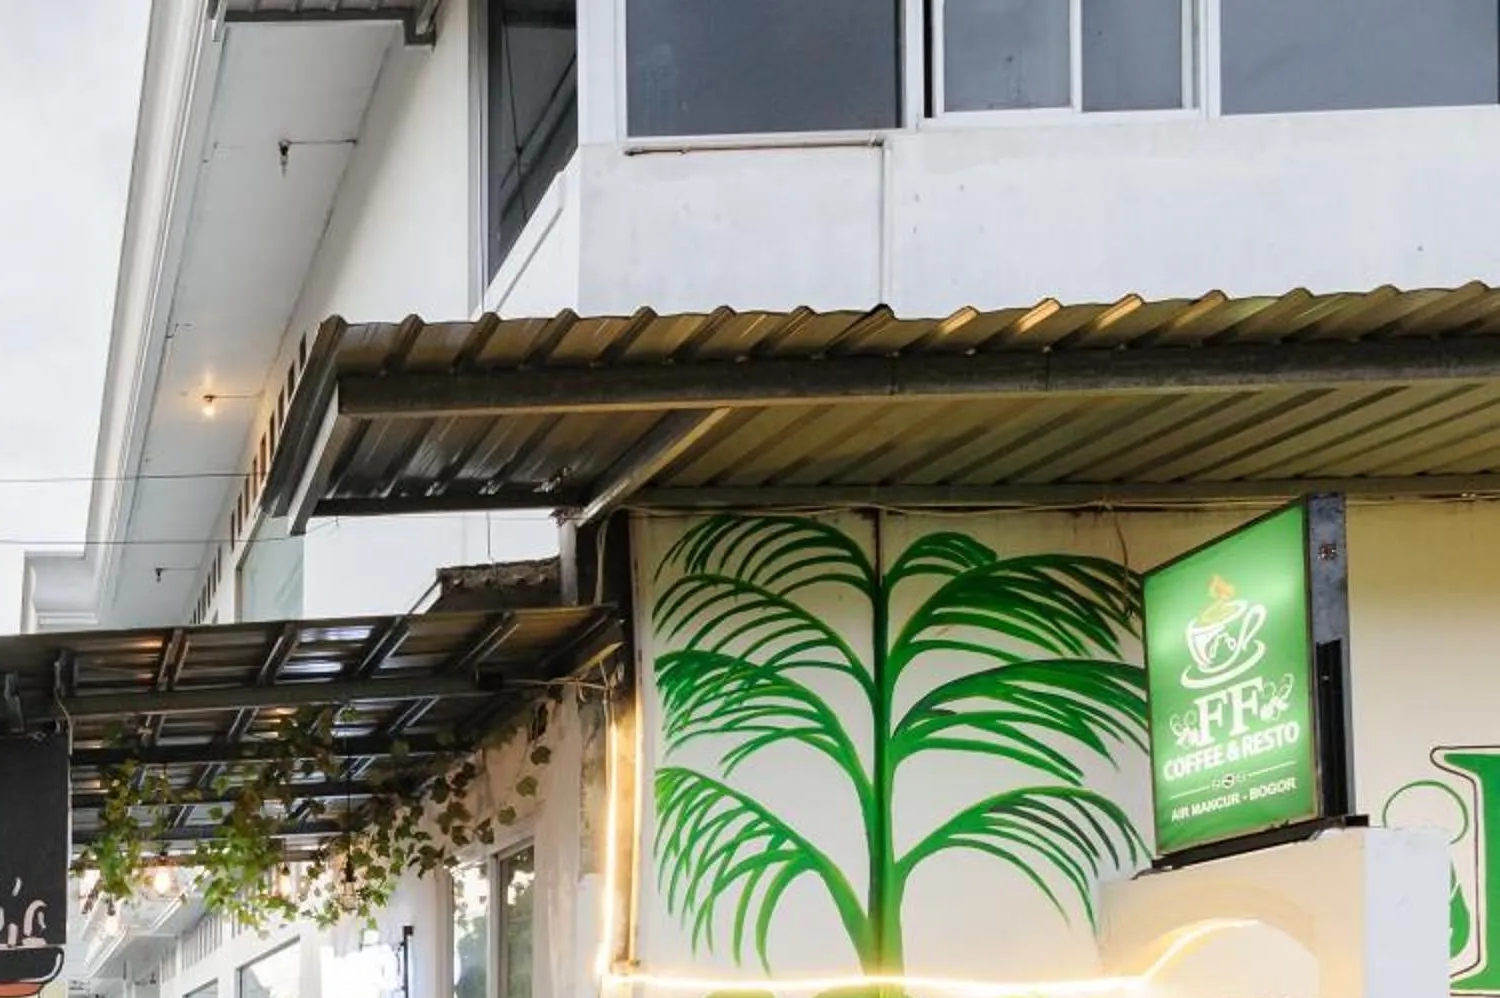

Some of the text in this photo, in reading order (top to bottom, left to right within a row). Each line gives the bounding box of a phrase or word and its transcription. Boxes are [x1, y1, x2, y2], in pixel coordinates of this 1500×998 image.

[1195, 677, 1265, 747] FF
[1163, 720, 1300, 781] COFFEE & RESTO
[1171, 805, 1190, 822] AIR
[1191, 792, 1241, 817] MANCUR
[1249, 776, 1297, 801] BOGOR
